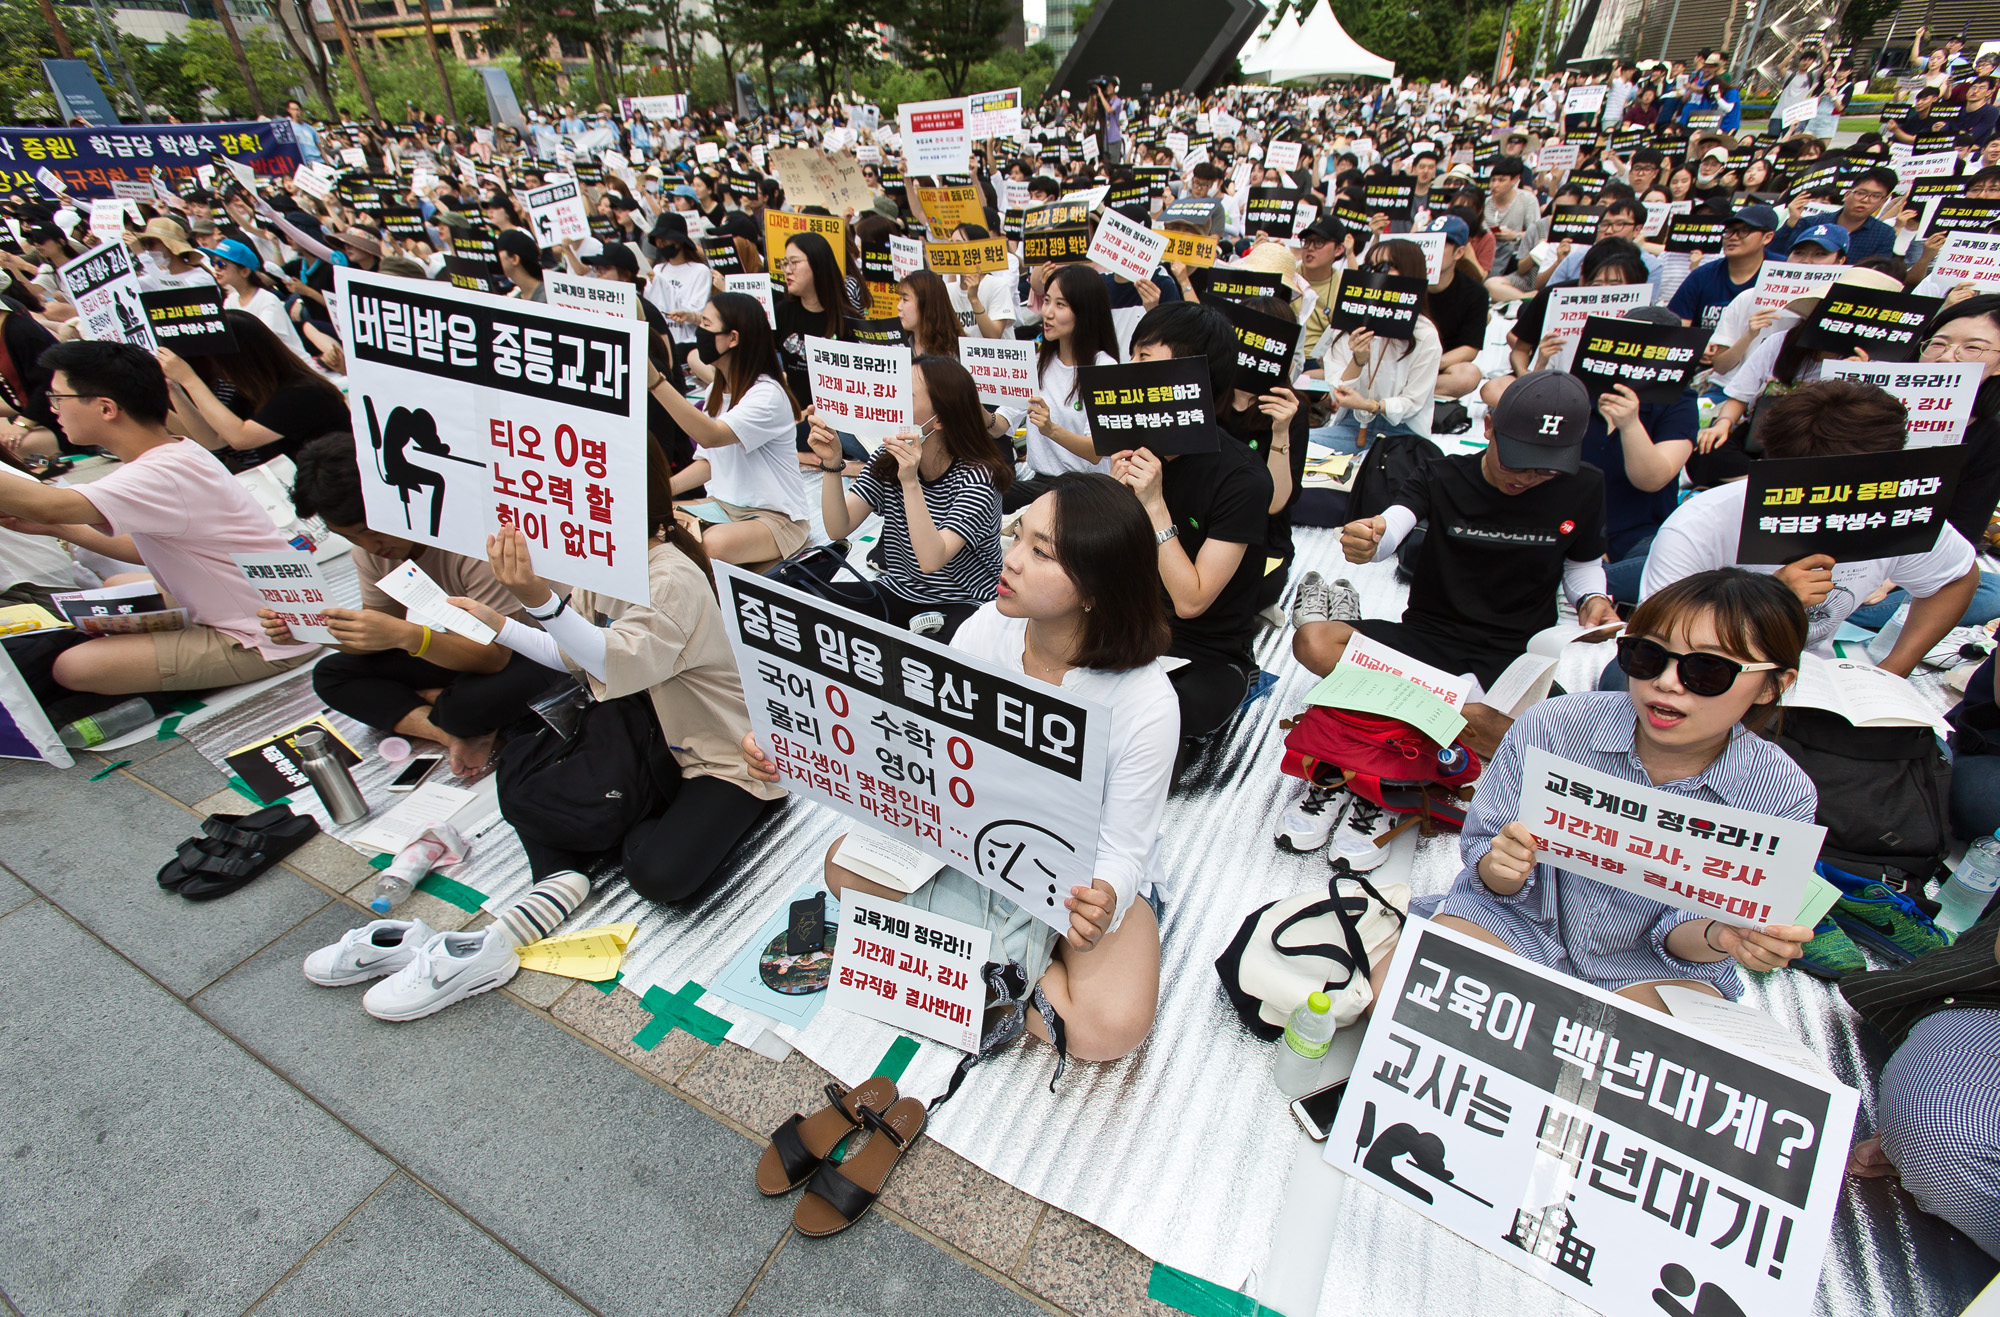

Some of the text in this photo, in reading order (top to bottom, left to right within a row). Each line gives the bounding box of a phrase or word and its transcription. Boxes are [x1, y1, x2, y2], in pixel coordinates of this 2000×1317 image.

[20, 134, 263, 159] 증원! 학급당 학생수 감축!
[769, 214, 790, 228] 디자인
[809, 219, 823, 232] 중등
[825, 220, 840, 234] 티오
[1052, 208, 1068, 225] 정원
[1070, 205, 1086, 223] 확보
[1431, 216, 1448, 231] S
[1049, 237, 1066, 256] 정원
[1069, 235, 1088, 255] 확보
[1102, 231, 1152, 263] 기간제 교사, 강사
[1133, 229, 1158, 250] 정유라!!
[1177, 239, 1212, 259] 정원 확보
[1952, 238, 1989, 250] 교육계의
[963, 248, 982, 265] 정원
[984, 245, 1004, 262] 확보
[1120, 256, 1149, 278] 결사반대!
[1947, 253, 1995, 267] 기간제 교사,
[1766, 268, 1801, 280] 교육계의
[552, 281, 625, 305] 교육계의 정유라!!
[1213, 282, 1275, 297] 교과 교사 증원하라
[1345, 285, 1418, 305] 교과 교사 증원하라
[1560, 292, 1640, 305] 교육계의 정유라!!
[1763, 283, 1789, 293] 기간제
[166, 307, 184, 318] 교사
[1341, 301, 1413, 321] 학급당 학생수 감축
[1560, 311, 1588, 321] 기간제
[1828, 301, 1925, 326] 교과 교사 증원하라
[1818, 318, 1914, 344] 학급당 학생수 감축
[351, 294, 628, 401] 버림받은 중등교과
[966, 346, 1027, 362] 교육계의 정유라!!
[1244, 331, 1287, 356] 증원하라
[1588, 337, 1695, 363] 교과 교사 증원하라
[813, 349, 897, 374] 교육계의 정유라!!
[969, 364, 1028, 380] 기간제 교사, 강사
[1258, 358, 1281, 376] 감축
[1582, 358, 1685, 383] 학급당 학생수 감축
[817, 374, 897, 399] 기간제 교사, 강사
[975, 382, 1034, 398] 규직화 결사반대!
[1895, 373, 1962, 389] 정유라!!
[1092, 383, 1201, 405] 교과 교사 증원하라
[1917, 397, 1953, 411] 강사
[815, 395, 904, 424] 정규직화 결사반대!
[1097, 409, 1205, 429] 학급당 학생수 감축
[1538, 413, 1565, 436] H
[490, 418, 545, 462] 티오
[493, 461, 615, 525] 노오력 할
[1762, 476, 1942, 506] 교과 교사 증원하라
[1759, 506, 1933, 534] 학급당 학생수 감축
[560, 520, 616, 567] 없다
[242, 564, 313, 578] 교육계의 정유라!!
[259, 589, 324, 604] 기간제 교사, 강사
[738, 592, 1076, 764] 중등 임용 울산 티오
[757, 659, 974, 771] 국어 0 수학 0
[766, 698, 975, 809] 물리 0 영어 0
[770, 732, 850, 784] 임고생이
[856, 770, 941, 826] 몇명인데
[774, 755, 854, 806] 타지역도
[860, 797, 943, 848] 마찬가지
[1544, 771, 1781, 857] 교육계의 정유라!!
[1543, 806, 1767, 887] 기간제 교사, 강사
[1529, 832, 1772, 924] 정규직화 결사반대!
[853, 906, 973, 960] 교육계의 정유라!!
[852, 937, 968, 991] 기간제 교사, 강사
[839, 966, 973, 1027] 정규직화 결사반대!
[1404, 956, 1817, 1172] 교육이 백년대계?
[1372, 1031, 1795, 1282] 교사는 백년대기!
